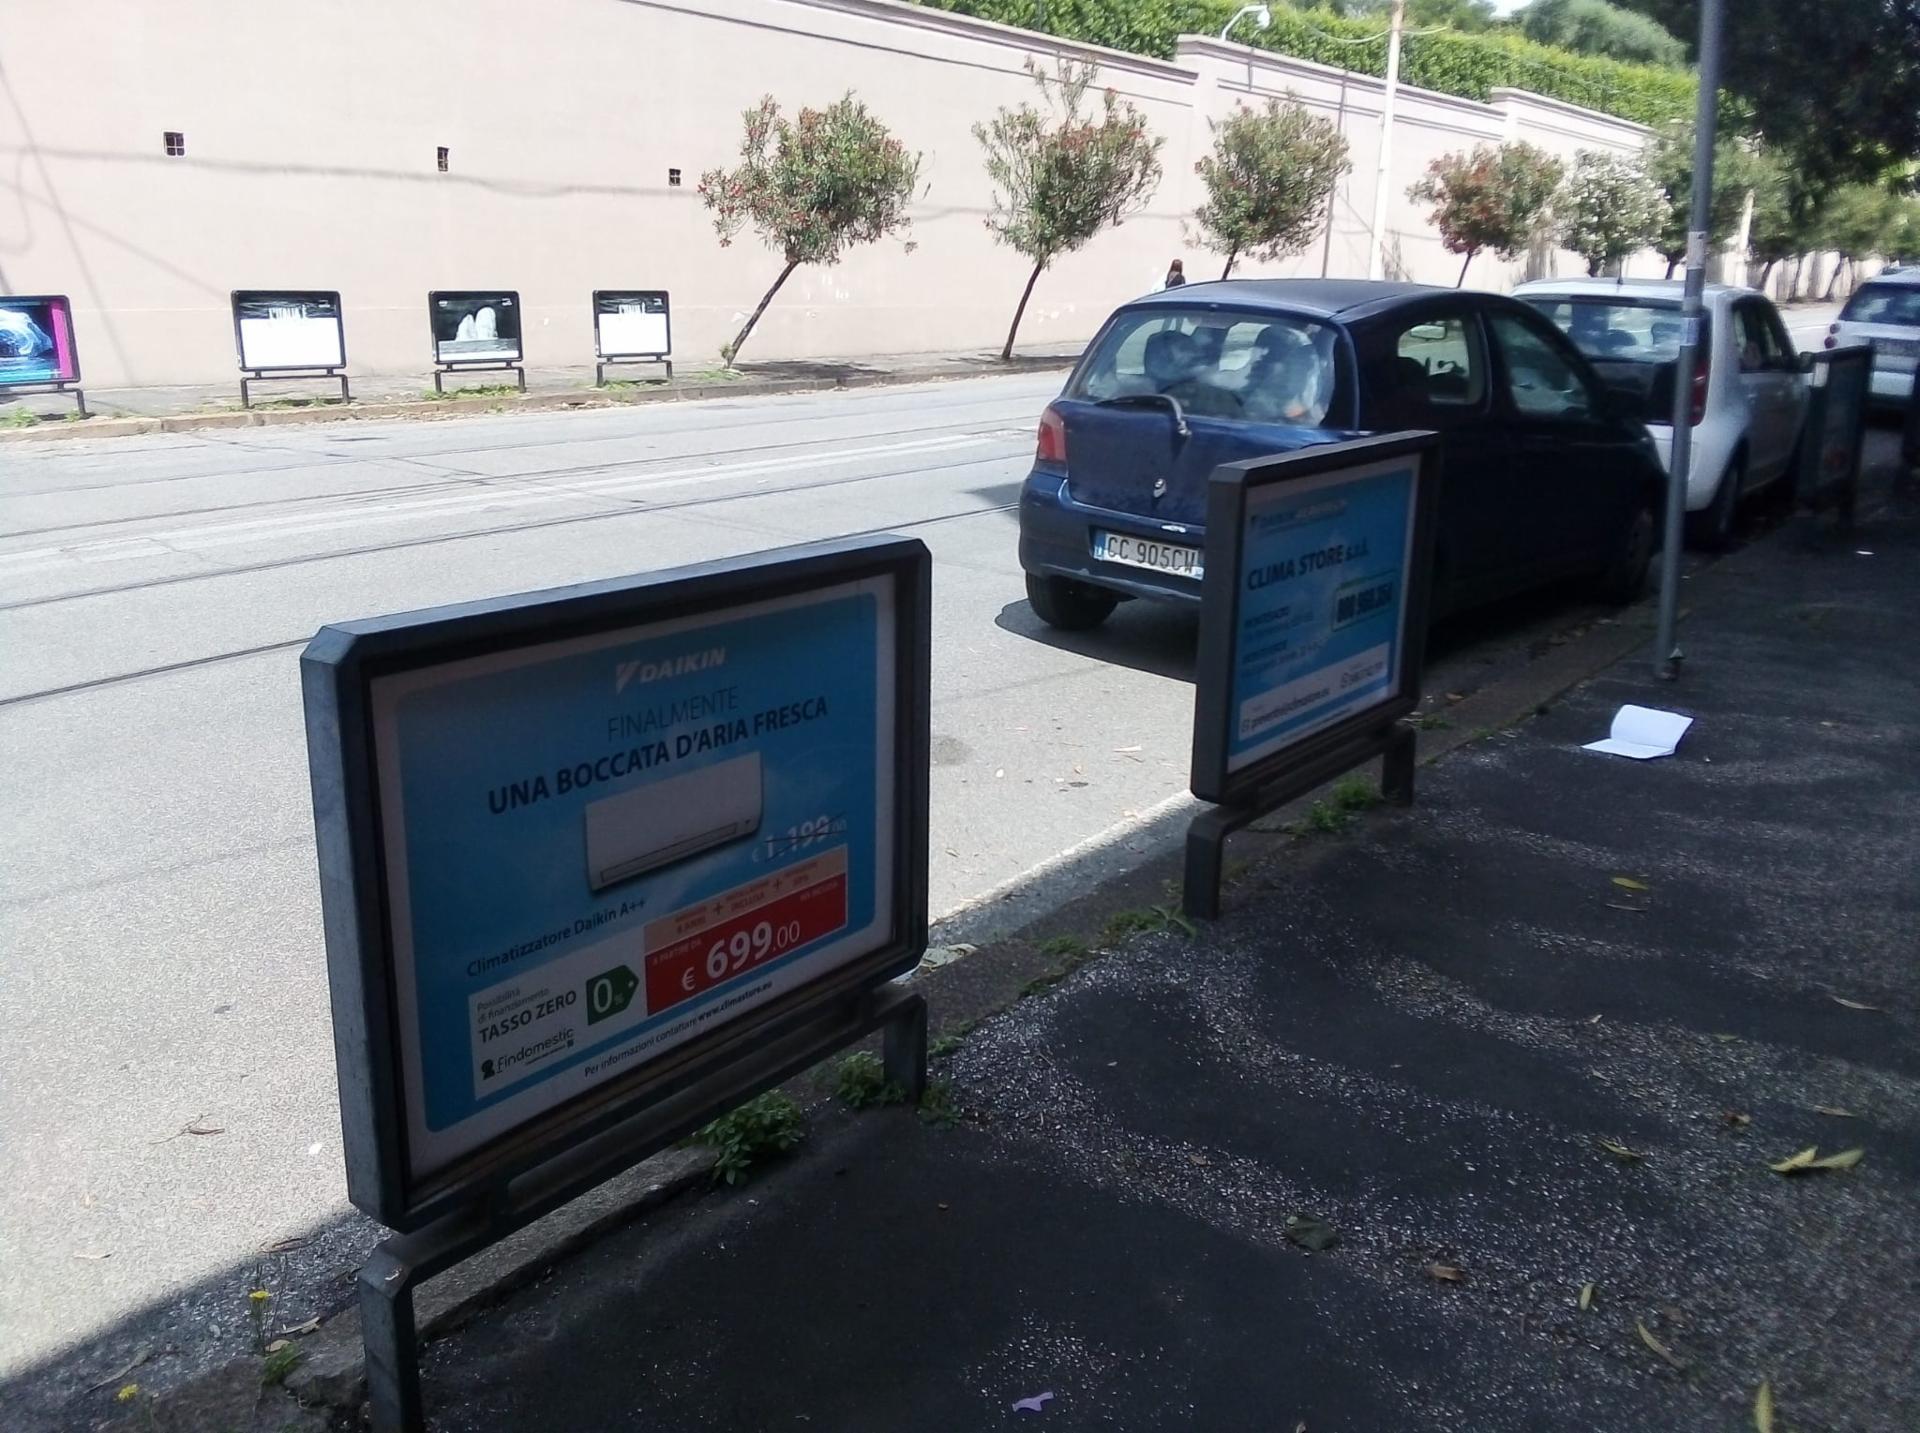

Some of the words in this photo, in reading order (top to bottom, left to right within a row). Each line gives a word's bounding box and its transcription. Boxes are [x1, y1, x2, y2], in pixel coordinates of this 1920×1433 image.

[1108, 536, 1129, 559] CC
[1247, 558, 1295, 591] CLIMA
[1298, 544, 1344, 576] STORE
[640, 647, 727, 684] DAIKIN
[607, 686, 740, 742] FINALMENTE
[488, 777, 550, 815] UNA
[557, 741, 670, 796] BOCCATA
[676, 718, 749, 759] D'ARIA
[753, 695, 829, 736] FRESCA
[466, 927, 571, 977] Climatizzatore
[574, 909, 617, 936] Daikin
[620, 899, 646, 918] A++
[681, 966, 697, 992] €
[478, 1010, 532, 1044] TASSO
[535, 990, 577, 1020] ZERO
[584, 1063, 600, 1078] Per
[600, 1036, 655, 1069] informazioni
